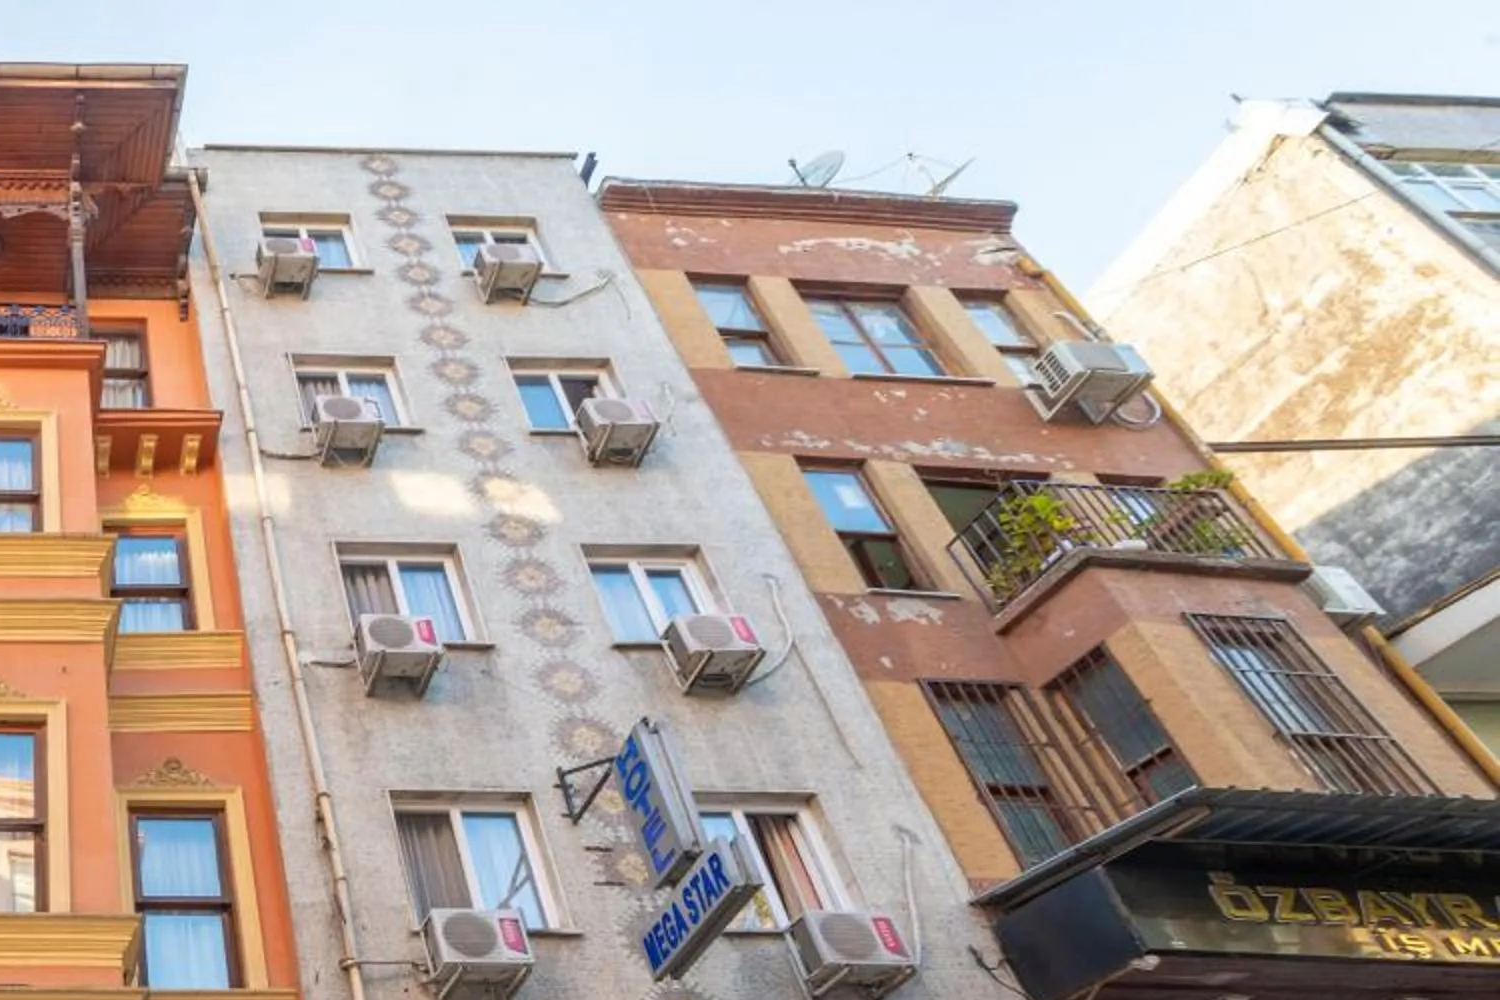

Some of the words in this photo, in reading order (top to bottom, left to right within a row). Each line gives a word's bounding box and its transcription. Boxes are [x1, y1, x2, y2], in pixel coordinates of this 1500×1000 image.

[615, 735, 675, 876] HOTEL
[643, 901, 691, 977] MEGA
[682, 851, 731, 925] STAR
[1207, 871, 1500, 931] ÖZBAYR
